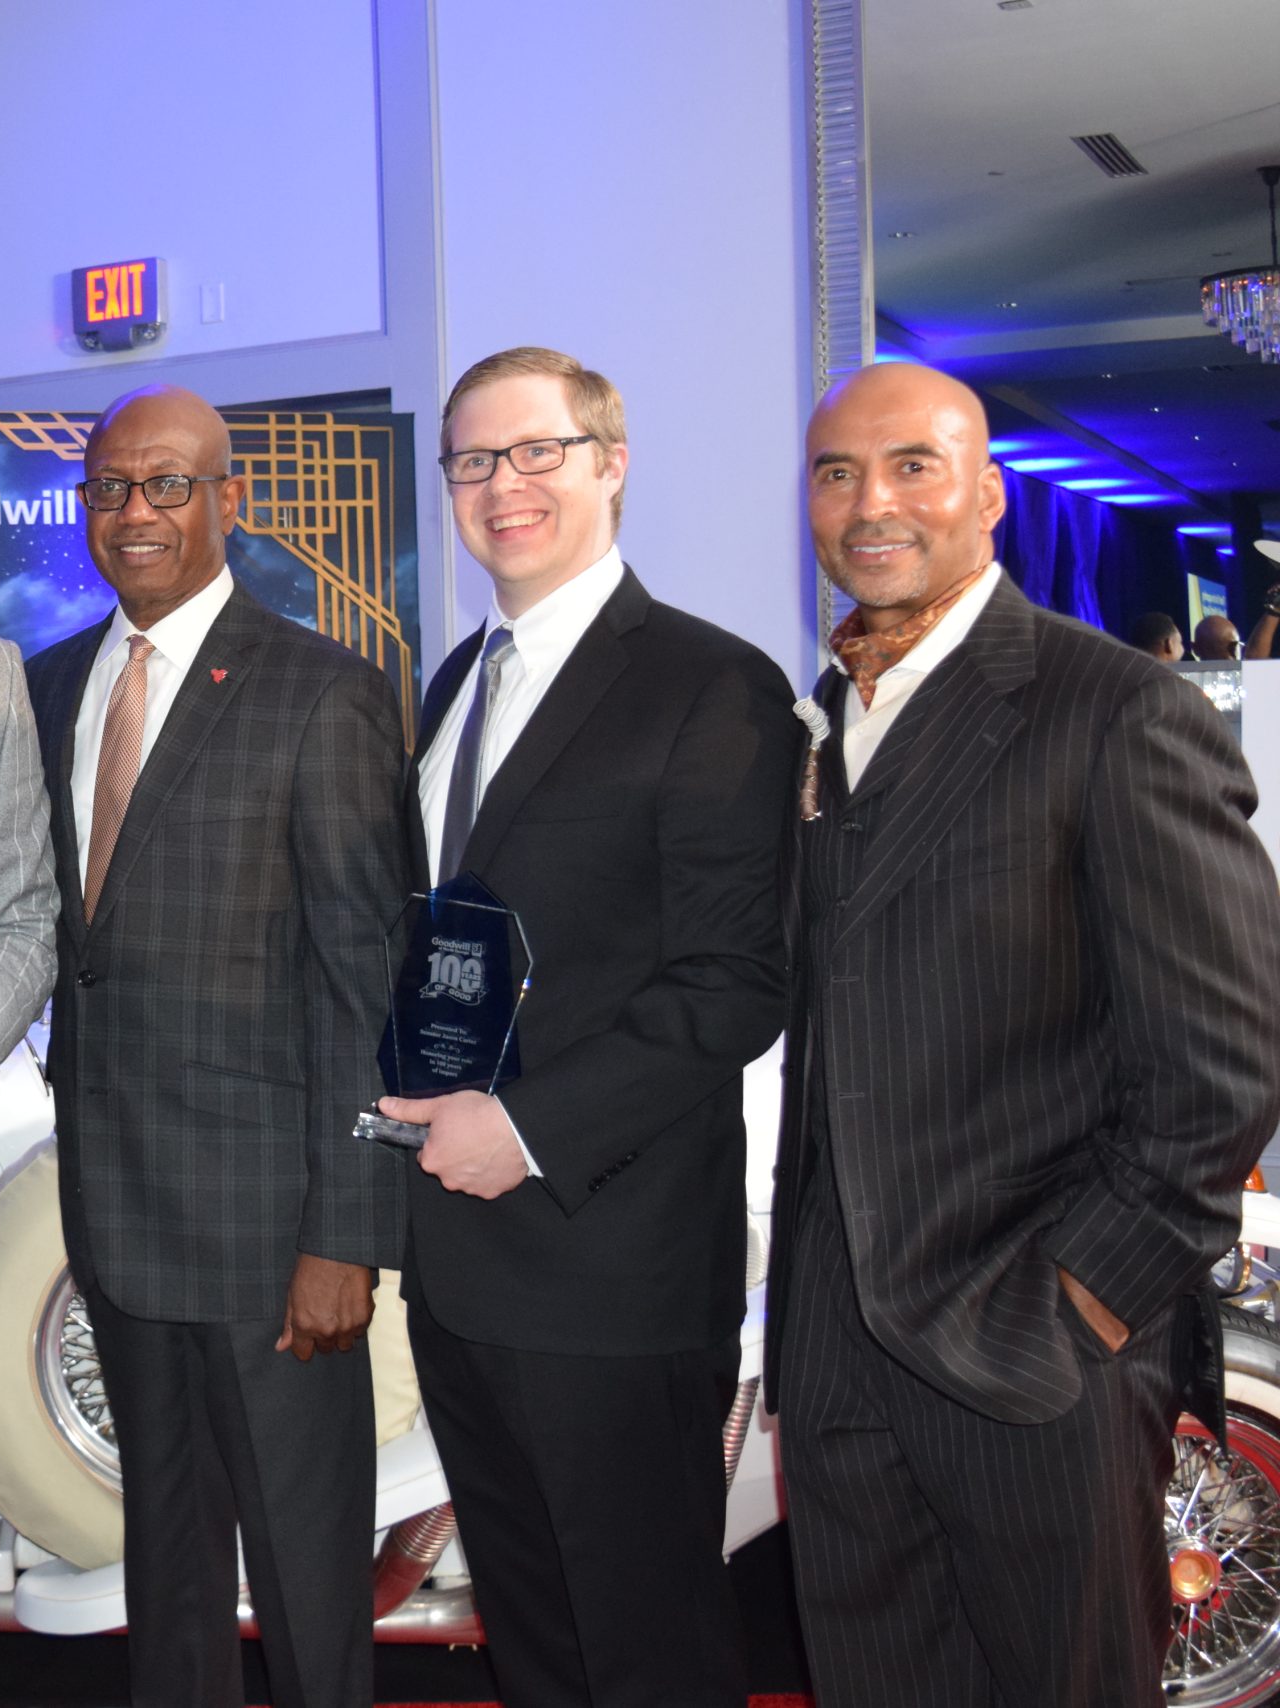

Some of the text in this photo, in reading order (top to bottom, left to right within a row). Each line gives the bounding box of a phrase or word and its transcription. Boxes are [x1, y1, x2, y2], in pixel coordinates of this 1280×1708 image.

[86, 263, 146, 322] EXIT
[431, 937, 471, 951] Goodwill
[427, 952, 482, 993] 100
[448, 988, 471, 1001] GOOD
